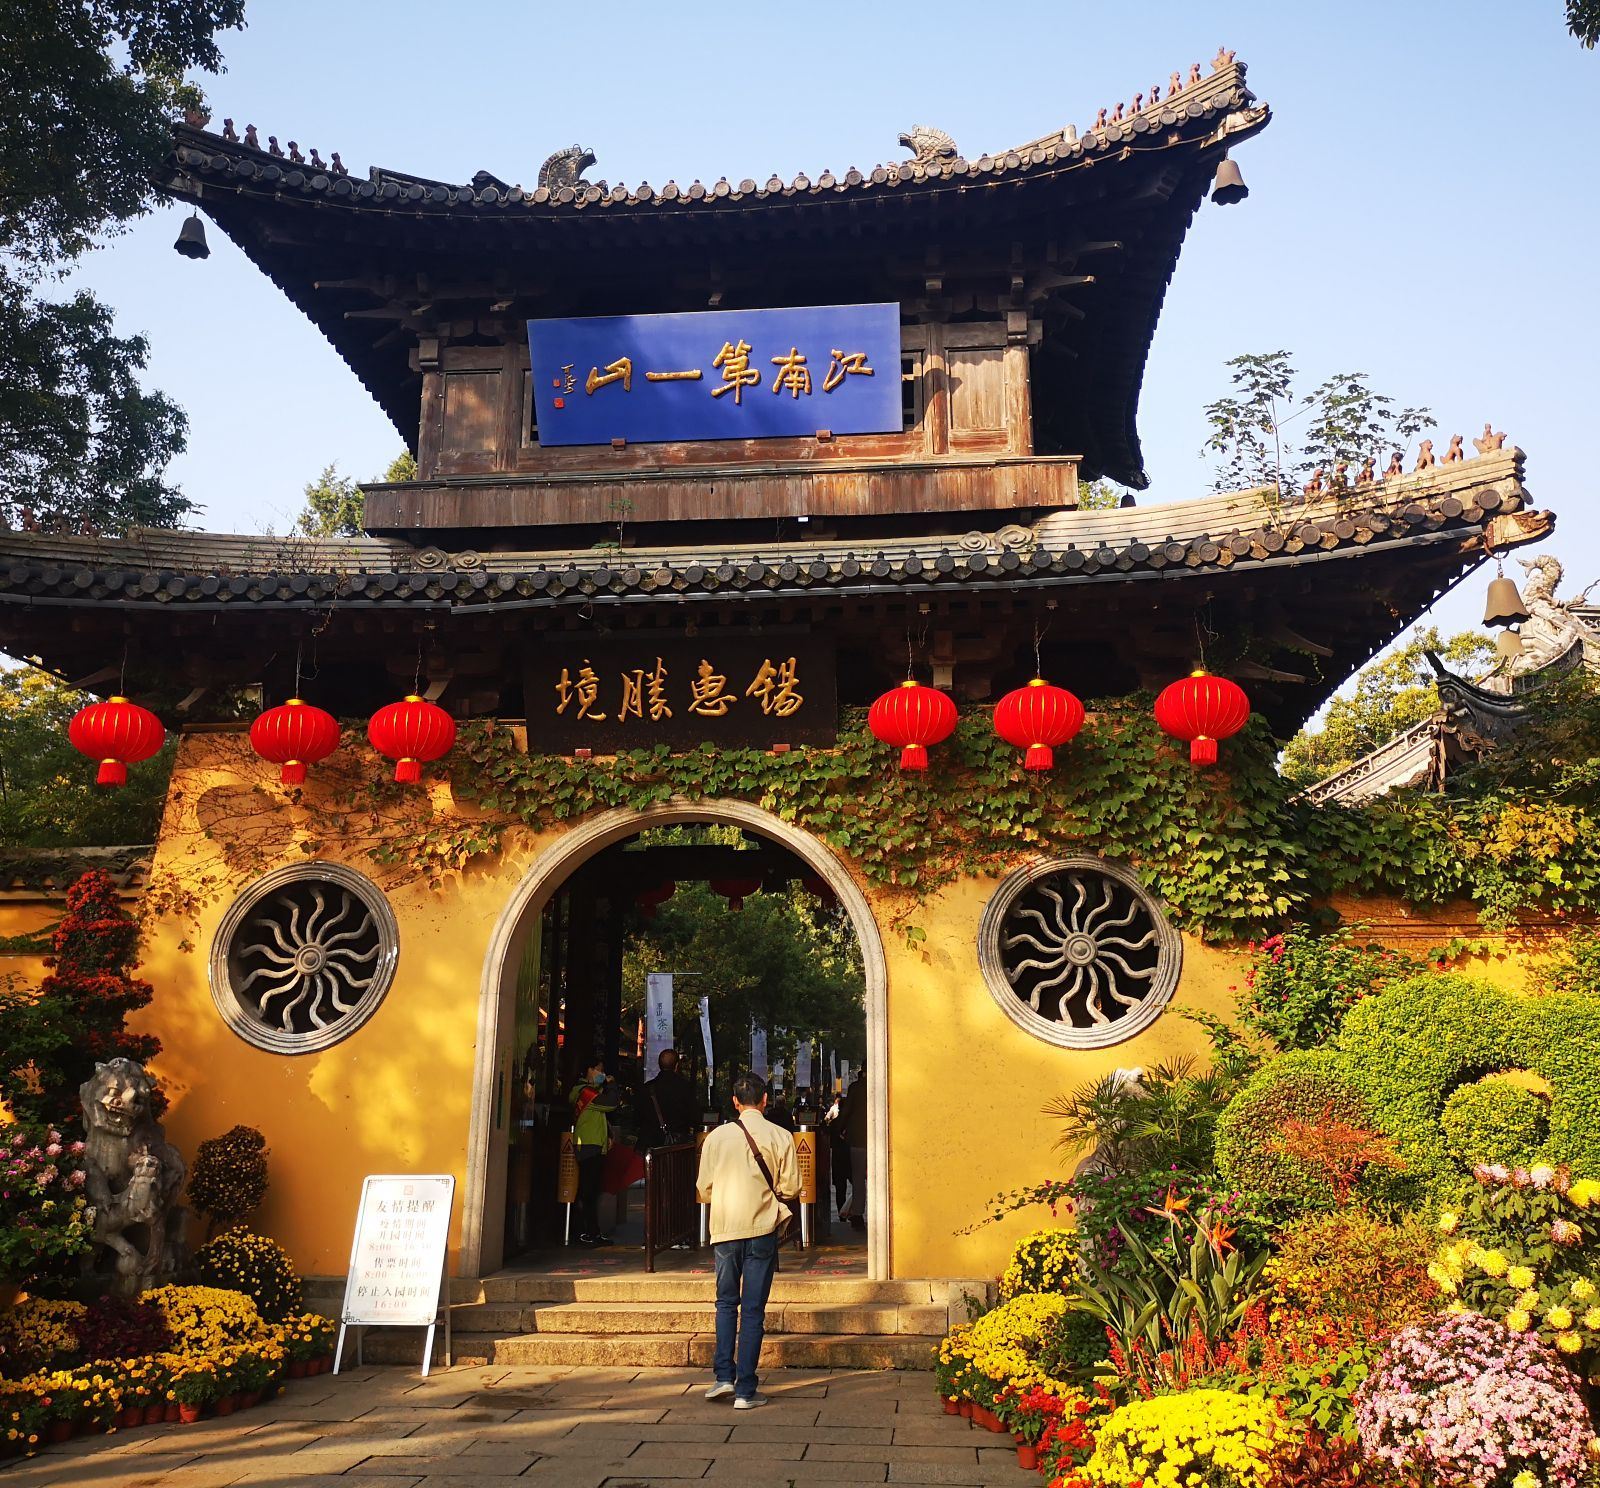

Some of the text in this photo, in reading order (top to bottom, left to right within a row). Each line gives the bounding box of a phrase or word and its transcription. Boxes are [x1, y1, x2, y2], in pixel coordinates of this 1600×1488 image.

[376, 1200, 435, 1213] 友情提醒
[357, 1286, 431, 1297] 停止入园时间
